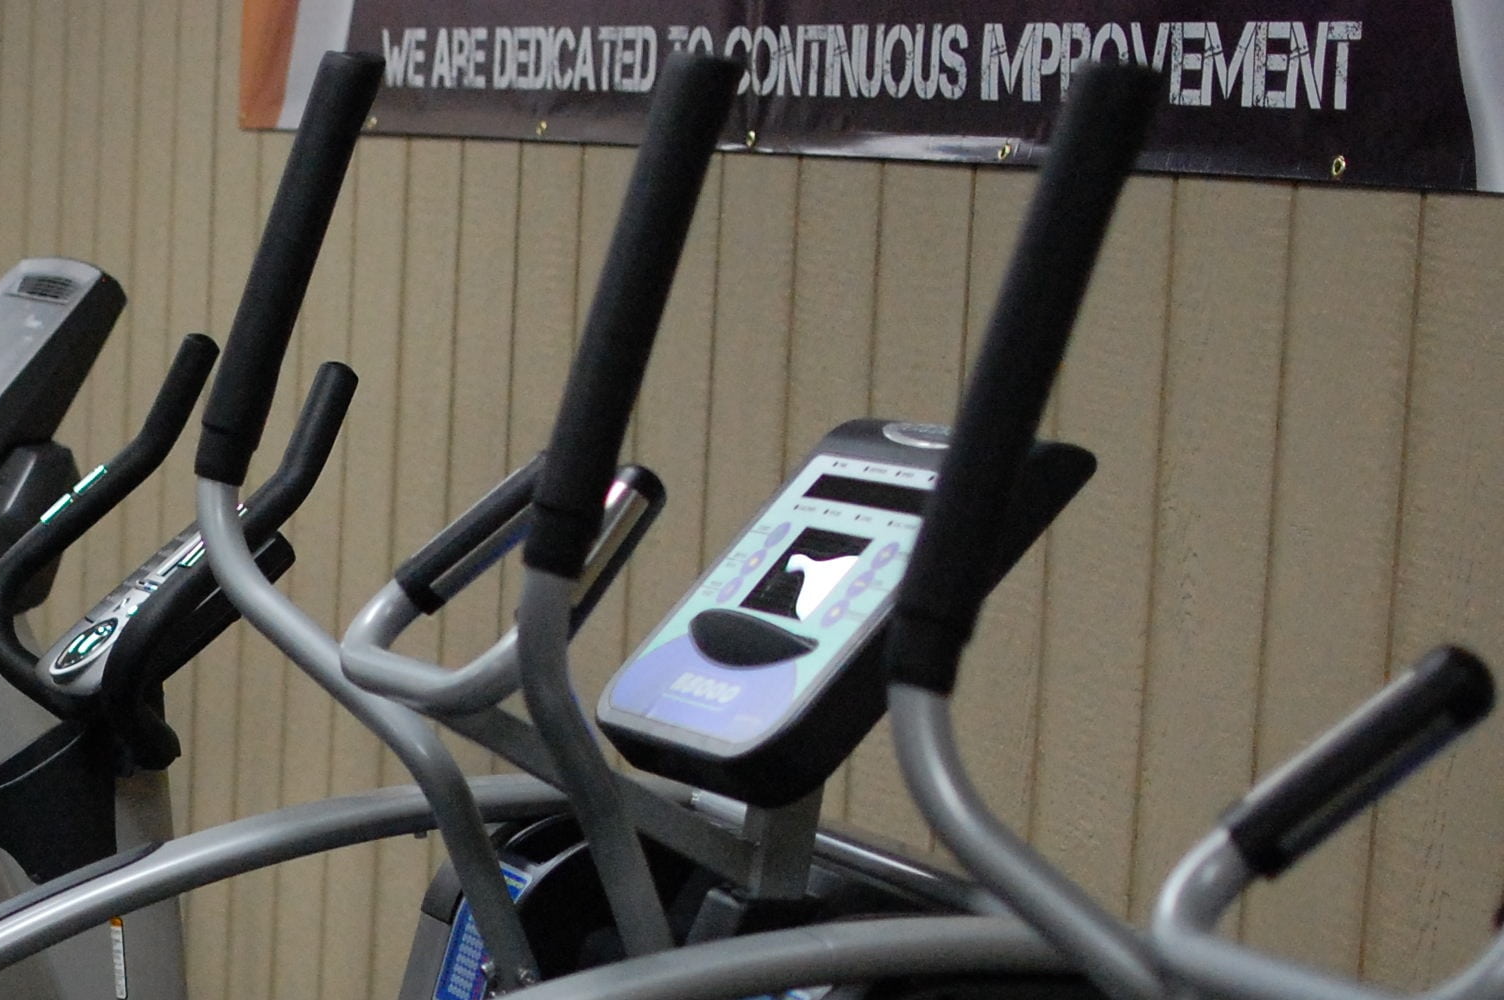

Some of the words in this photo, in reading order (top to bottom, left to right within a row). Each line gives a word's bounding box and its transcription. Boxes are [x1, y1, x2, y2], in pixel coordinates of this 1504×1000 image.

[382, 27, 427, 88] WE
[431, 27, 488, 89] ARE
[493, 25, 658, 92] DEDICATED
[724, 22, 969, 100] CONTINUOUS
[981, 21, 1363, 110] IMPROVEMENT
